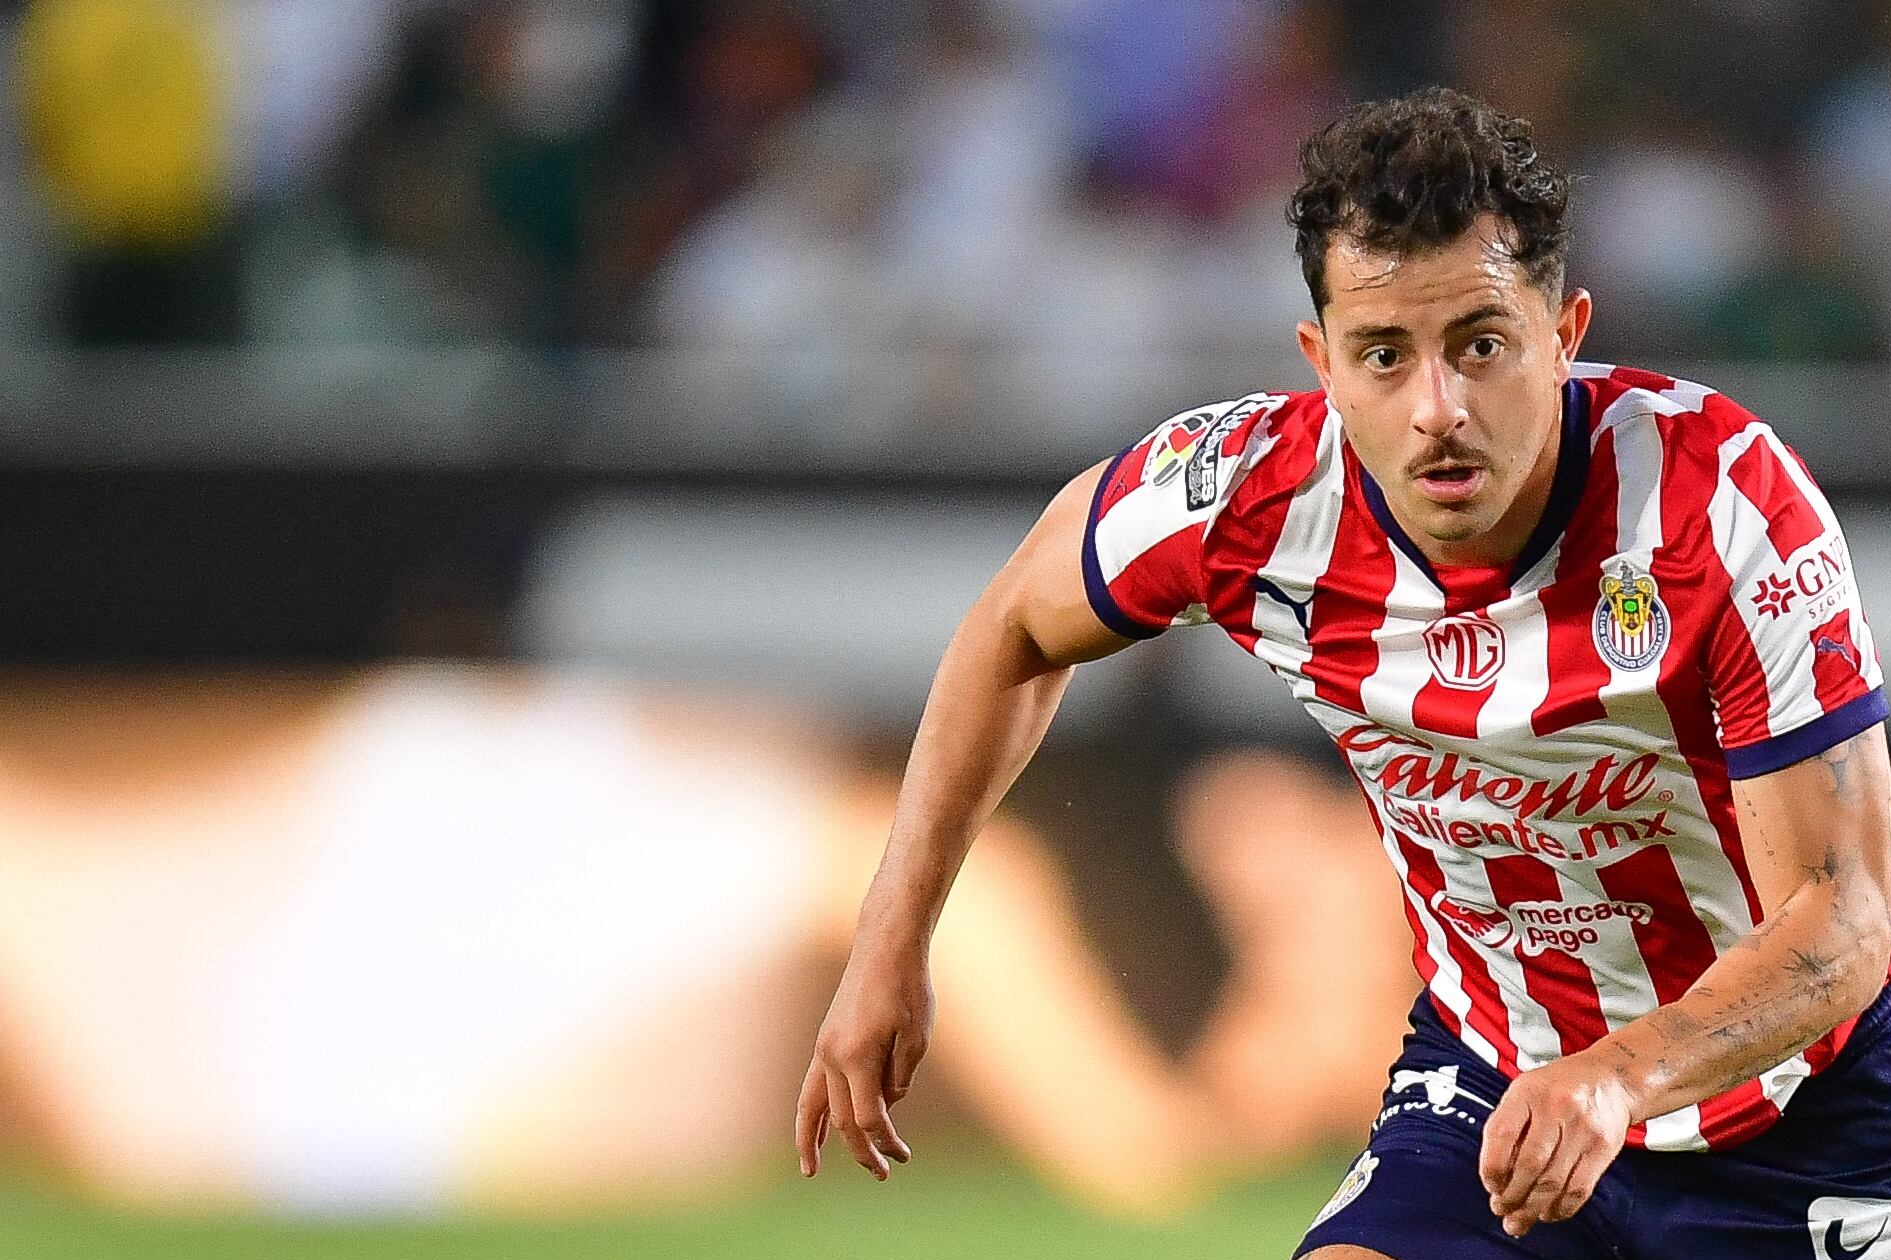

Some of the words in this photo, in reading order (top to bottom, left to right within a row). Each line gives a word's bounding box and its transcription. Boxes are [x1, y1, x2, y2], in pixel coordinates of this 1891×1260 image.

[1795, 535, 1847, 597] GNP
[1430, 623, 1498, 680] MG
[1526, 927, 1599, 952] pago
